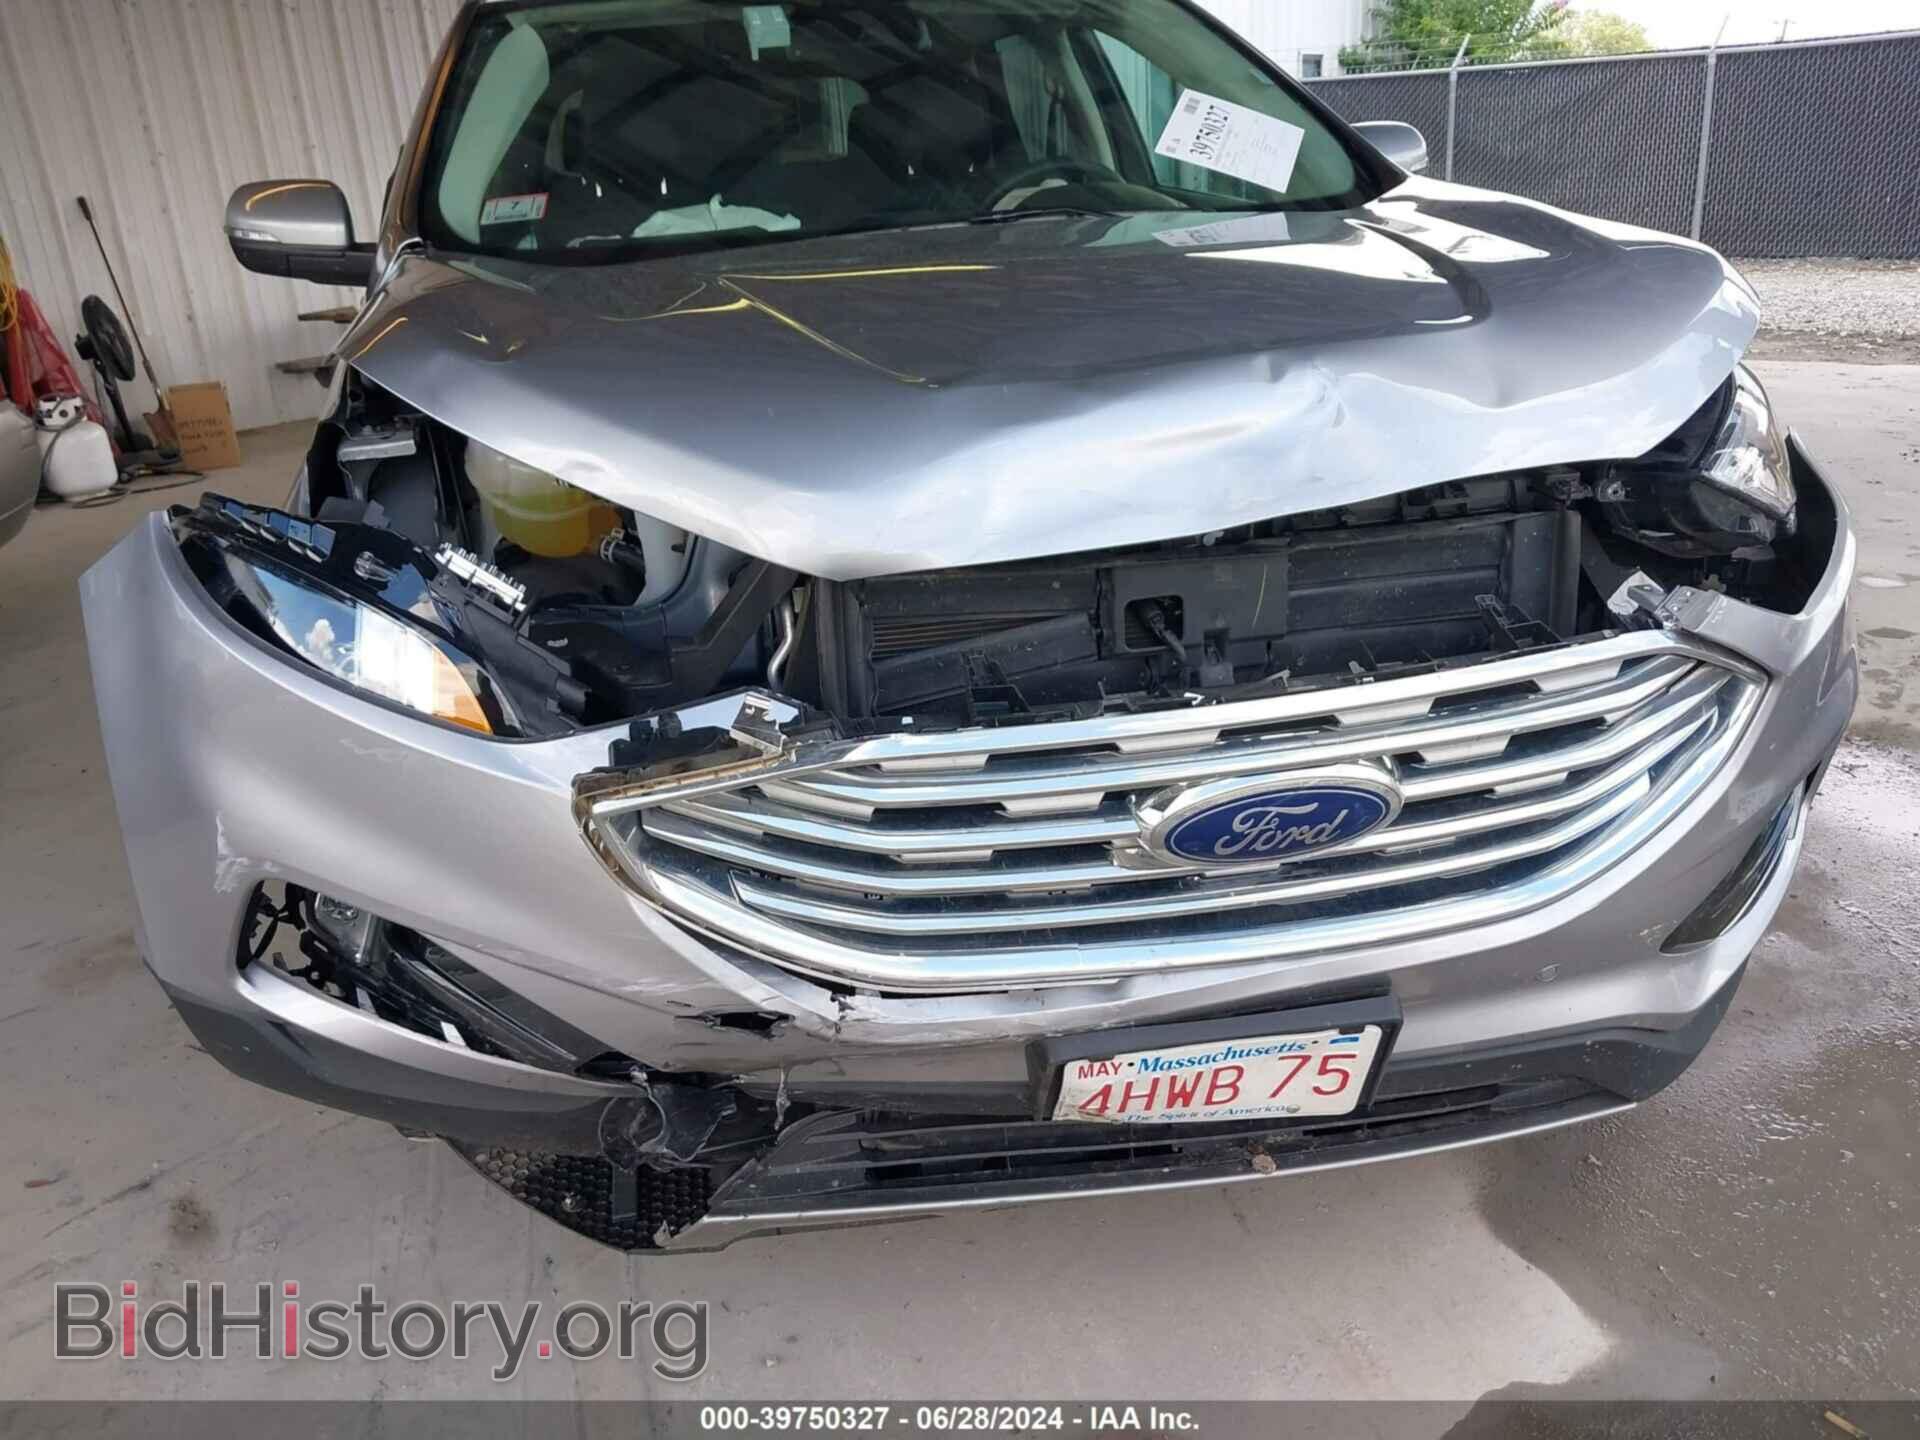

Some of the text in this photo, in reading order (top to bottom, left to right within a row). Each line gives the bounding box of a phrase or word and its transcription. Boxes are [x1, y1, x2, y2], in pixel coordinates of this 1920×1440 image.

[1214, 802, 1349, 856] Ford
[1078, 1041, 1308, 1079] MAY Massachusetts
[1078, 1053, 1358, 1116] 4HWB 75
